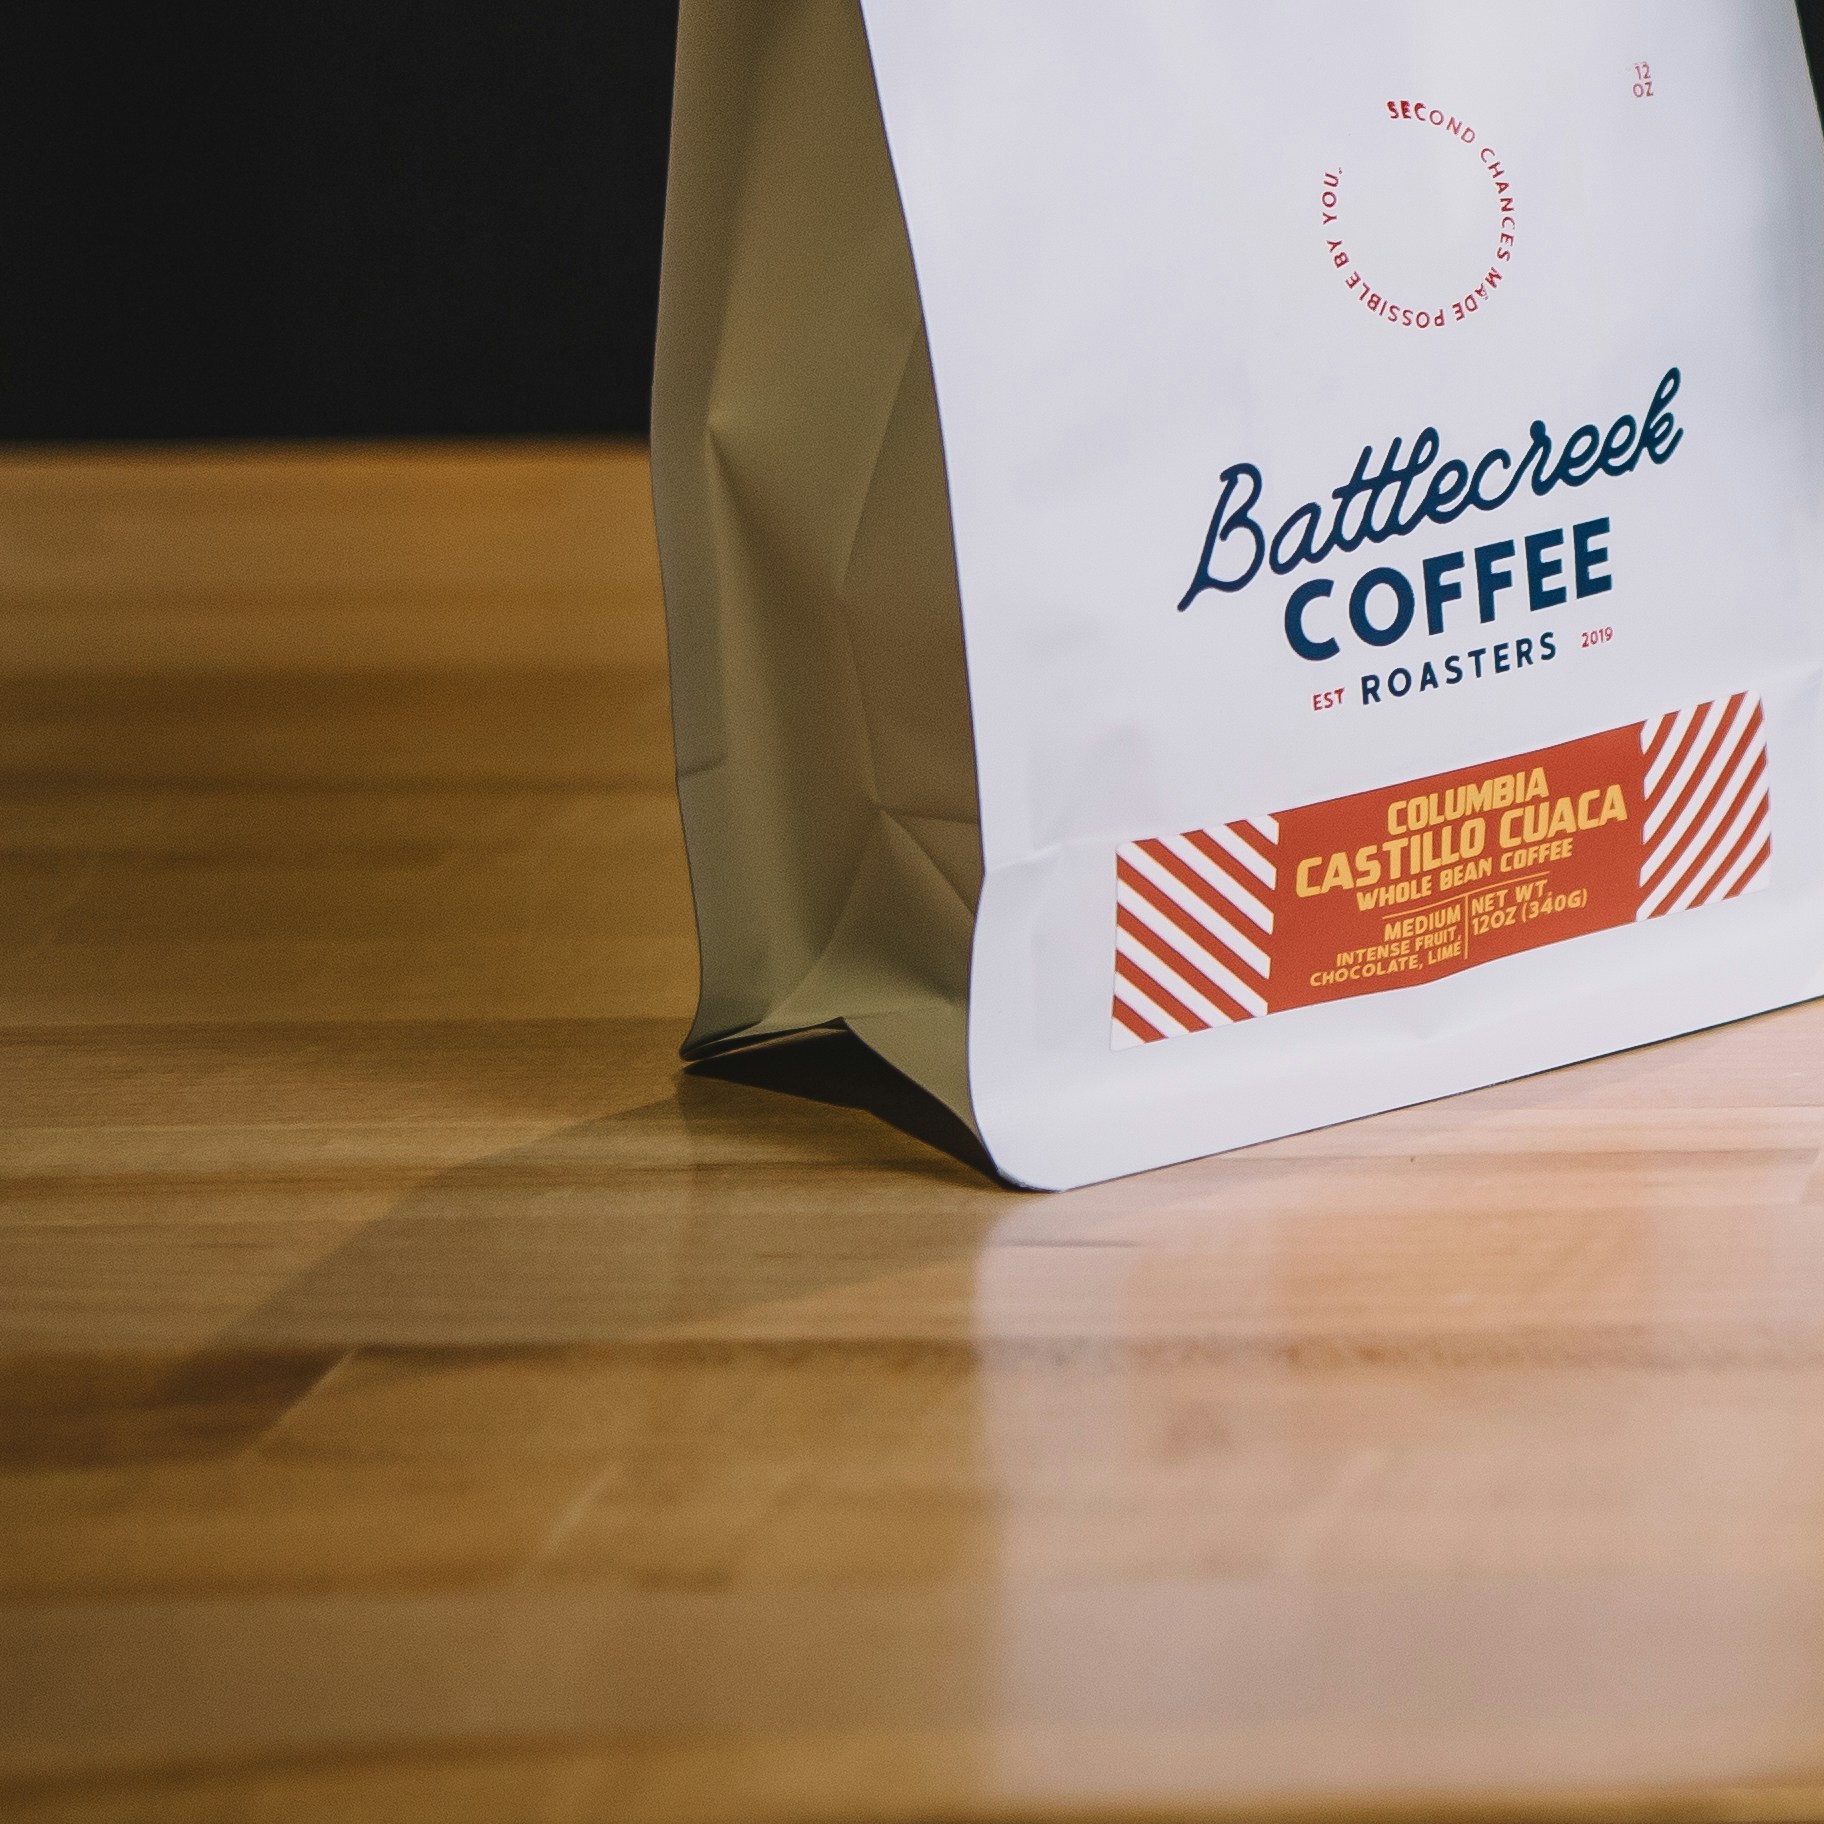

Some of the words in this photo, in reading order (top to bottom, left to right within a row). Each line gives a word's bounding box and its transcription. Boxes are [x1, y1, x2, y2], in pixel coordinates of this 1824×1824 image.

[1632, 81, 1654, 98] OZ
[1633, 62, 1652, 81] 12
[1386, 99, 1477, 144] SECOND
[1480, 147, 1515, 263] CHANCES
[1326, 238, 1350, 268] BY
[1344, 271, 1446, 329] POSSIBLE
[1452, 266, 1503, 321] MADE
[1177, 366, 1684, 613] Battlecreek
[1284, 516, 1613, 662] COFFEE
[1312, 687, 1346, 712] EST
[1361, 631, 1558, 706] ROASTERS
[1581, 626, 1614, 648] 2019
[1387, 766, 1550, 836] COLUMBIA
[1295, 816, 1487, 898] CASTILLO
[1499, 783, 1628, 850] CUACA
[1356, 874, 1432, 912] WHOLE
[1439, 856, 1493, 892] BEAN
[1500, 837, 1574, 873] COFFEE
[1383, 903, 1462, 942] MEDIUM
[1471, 888, 1513, 916] NET
[1520, 888, 1588, 924] (340G)
[1310, 956, 1424, 987] CHOCOLATE,
[1428, 941, 1463, 965] LIME
[1336, 939, 1410, 967] INTENSE
[1415, 925, 1462, 951] FRUIT,
